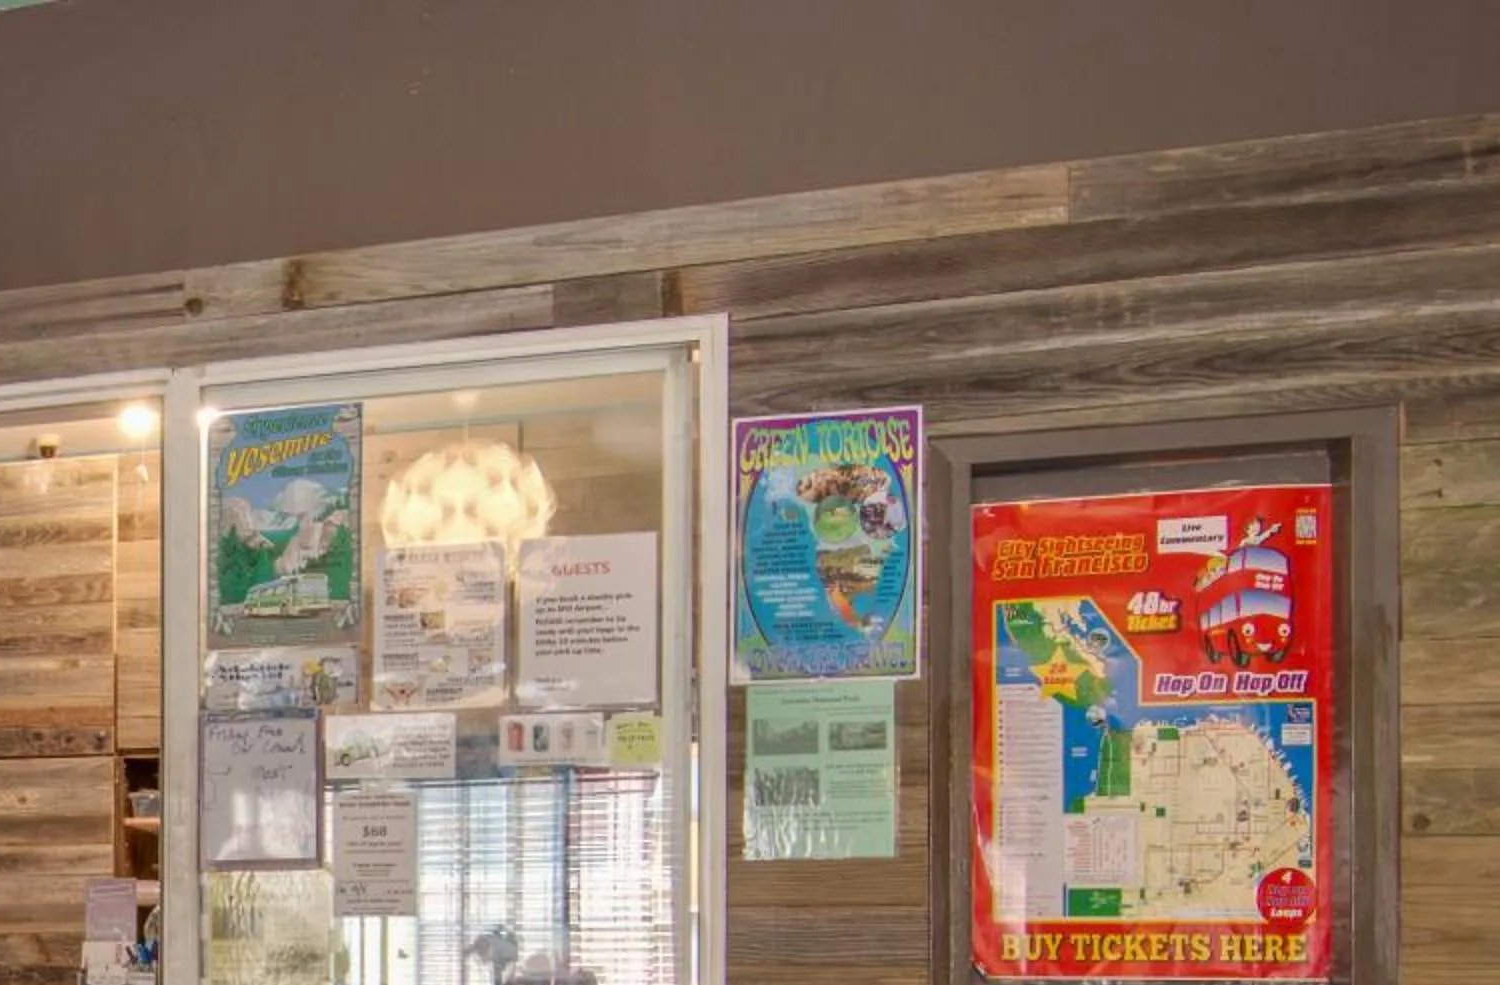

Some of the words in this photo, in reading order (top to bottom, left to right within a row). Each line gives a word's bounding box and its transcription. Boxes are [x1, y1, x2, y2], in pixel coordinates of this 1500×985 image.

[739, 422, 812, 472] GREEN
[817, 416, 915, 463] TORTOISE
[999, 540, 1036, 560] City
[1038, 533, 1145, 558] Sightseeing
[551, 561, 611, 577] GUESTS
[993, 559, 1036, 581] San
[1038, 553, 1149, 578] Francisco
[1127, 612, 1178, 631] Ticket
[1156, 674, 1196, 696] Hop
[1198, 672, 1228, 692] On
[1233, 672, 1274, 696] Hop
[1002, 933, 1063, 962] BUY
[1071, 933, 1211, 962] TICKETS
[1219, 933, 1308, 962] HERE
